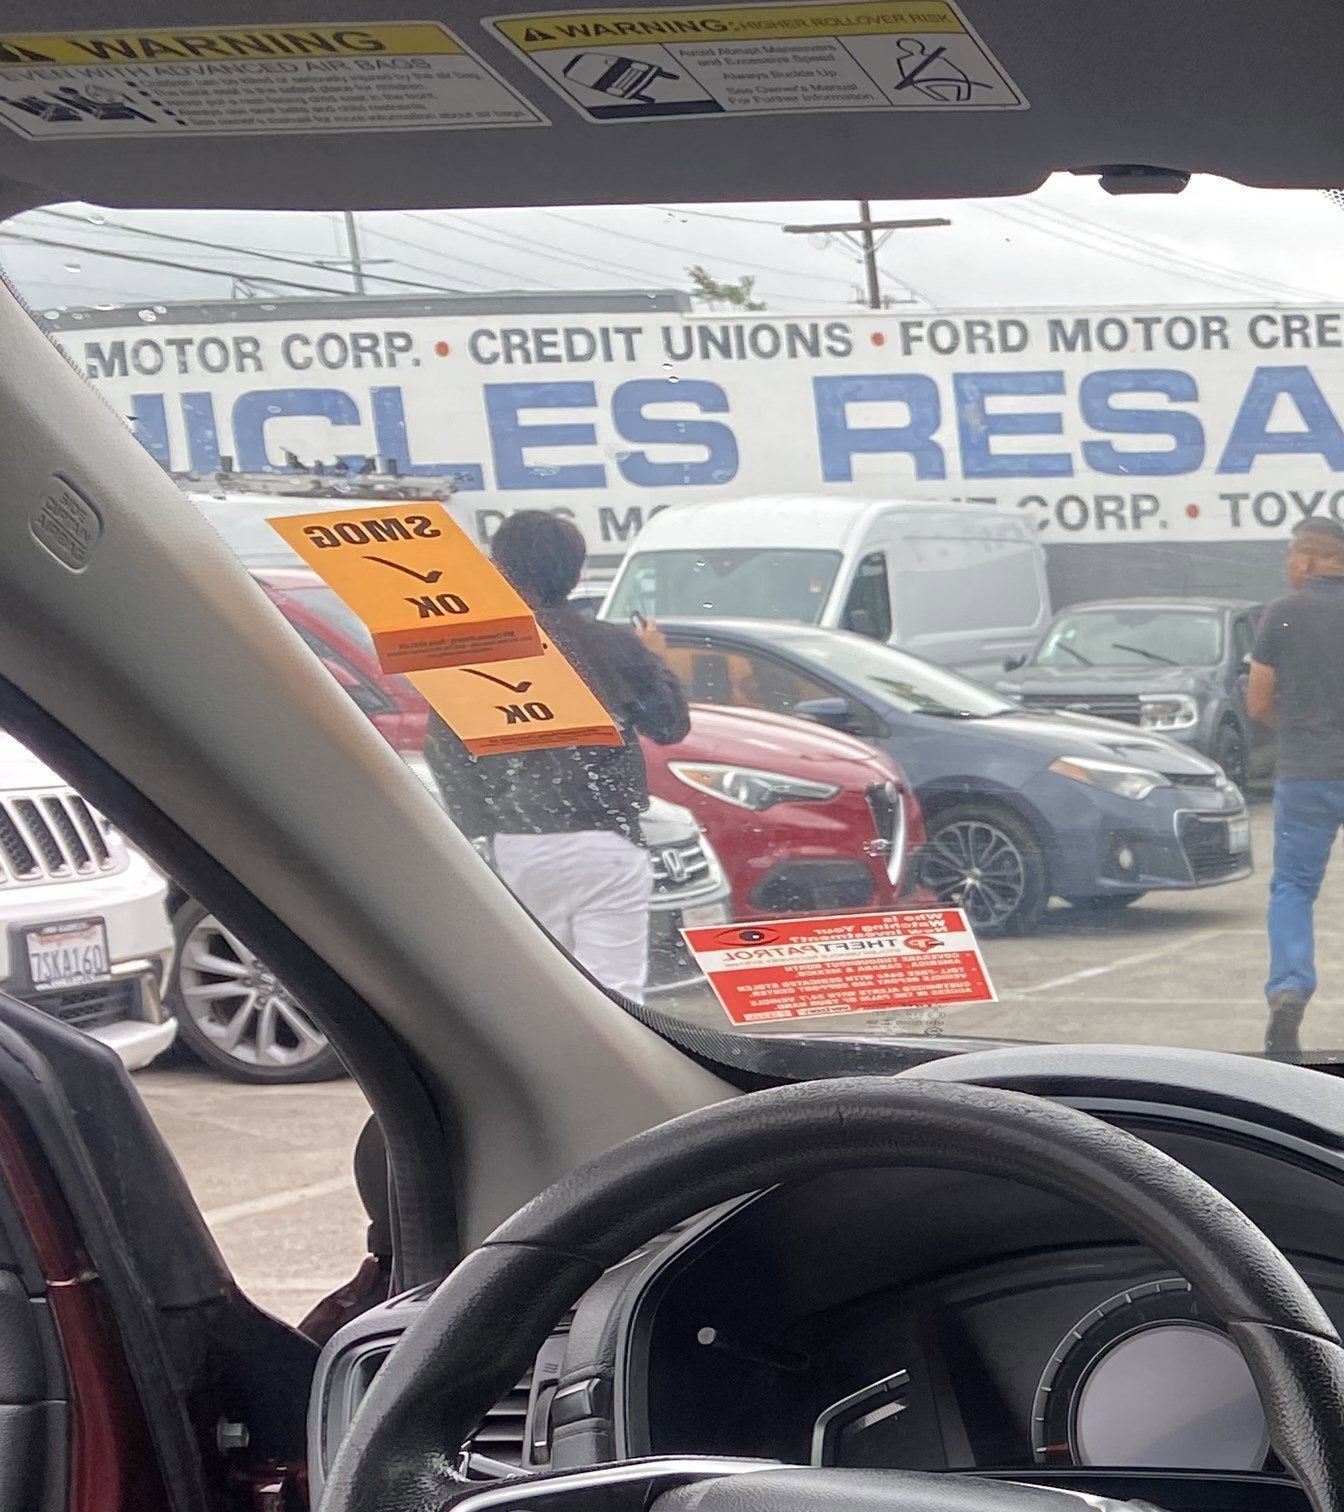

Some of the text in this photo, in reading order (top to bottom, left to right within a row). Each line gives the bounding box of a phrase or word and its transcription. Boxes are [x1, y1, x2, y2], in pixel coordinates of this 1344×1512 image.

[740, 18, 810, 31] HIGHER
[812, 16, 906, 28] ROLLOVER
[909, 14, 948, 24] RISK
[67, 31, 386, 60] WARNING
[155, 62, 298, 77] ADVANCED
[306, 60, 352, 72] AIR
[354, 59, 432, 70] BAGS
[85, 335, 264, 379] MOTOR
[281, 332, 421, 372] CORP.
[468, 326, 642, 365] CREDIT
[663, 322, 854, 362] UNIONS
[903, 318, 1030, 357] FORD
[1049, 314, 1230, 353] MOTOR
